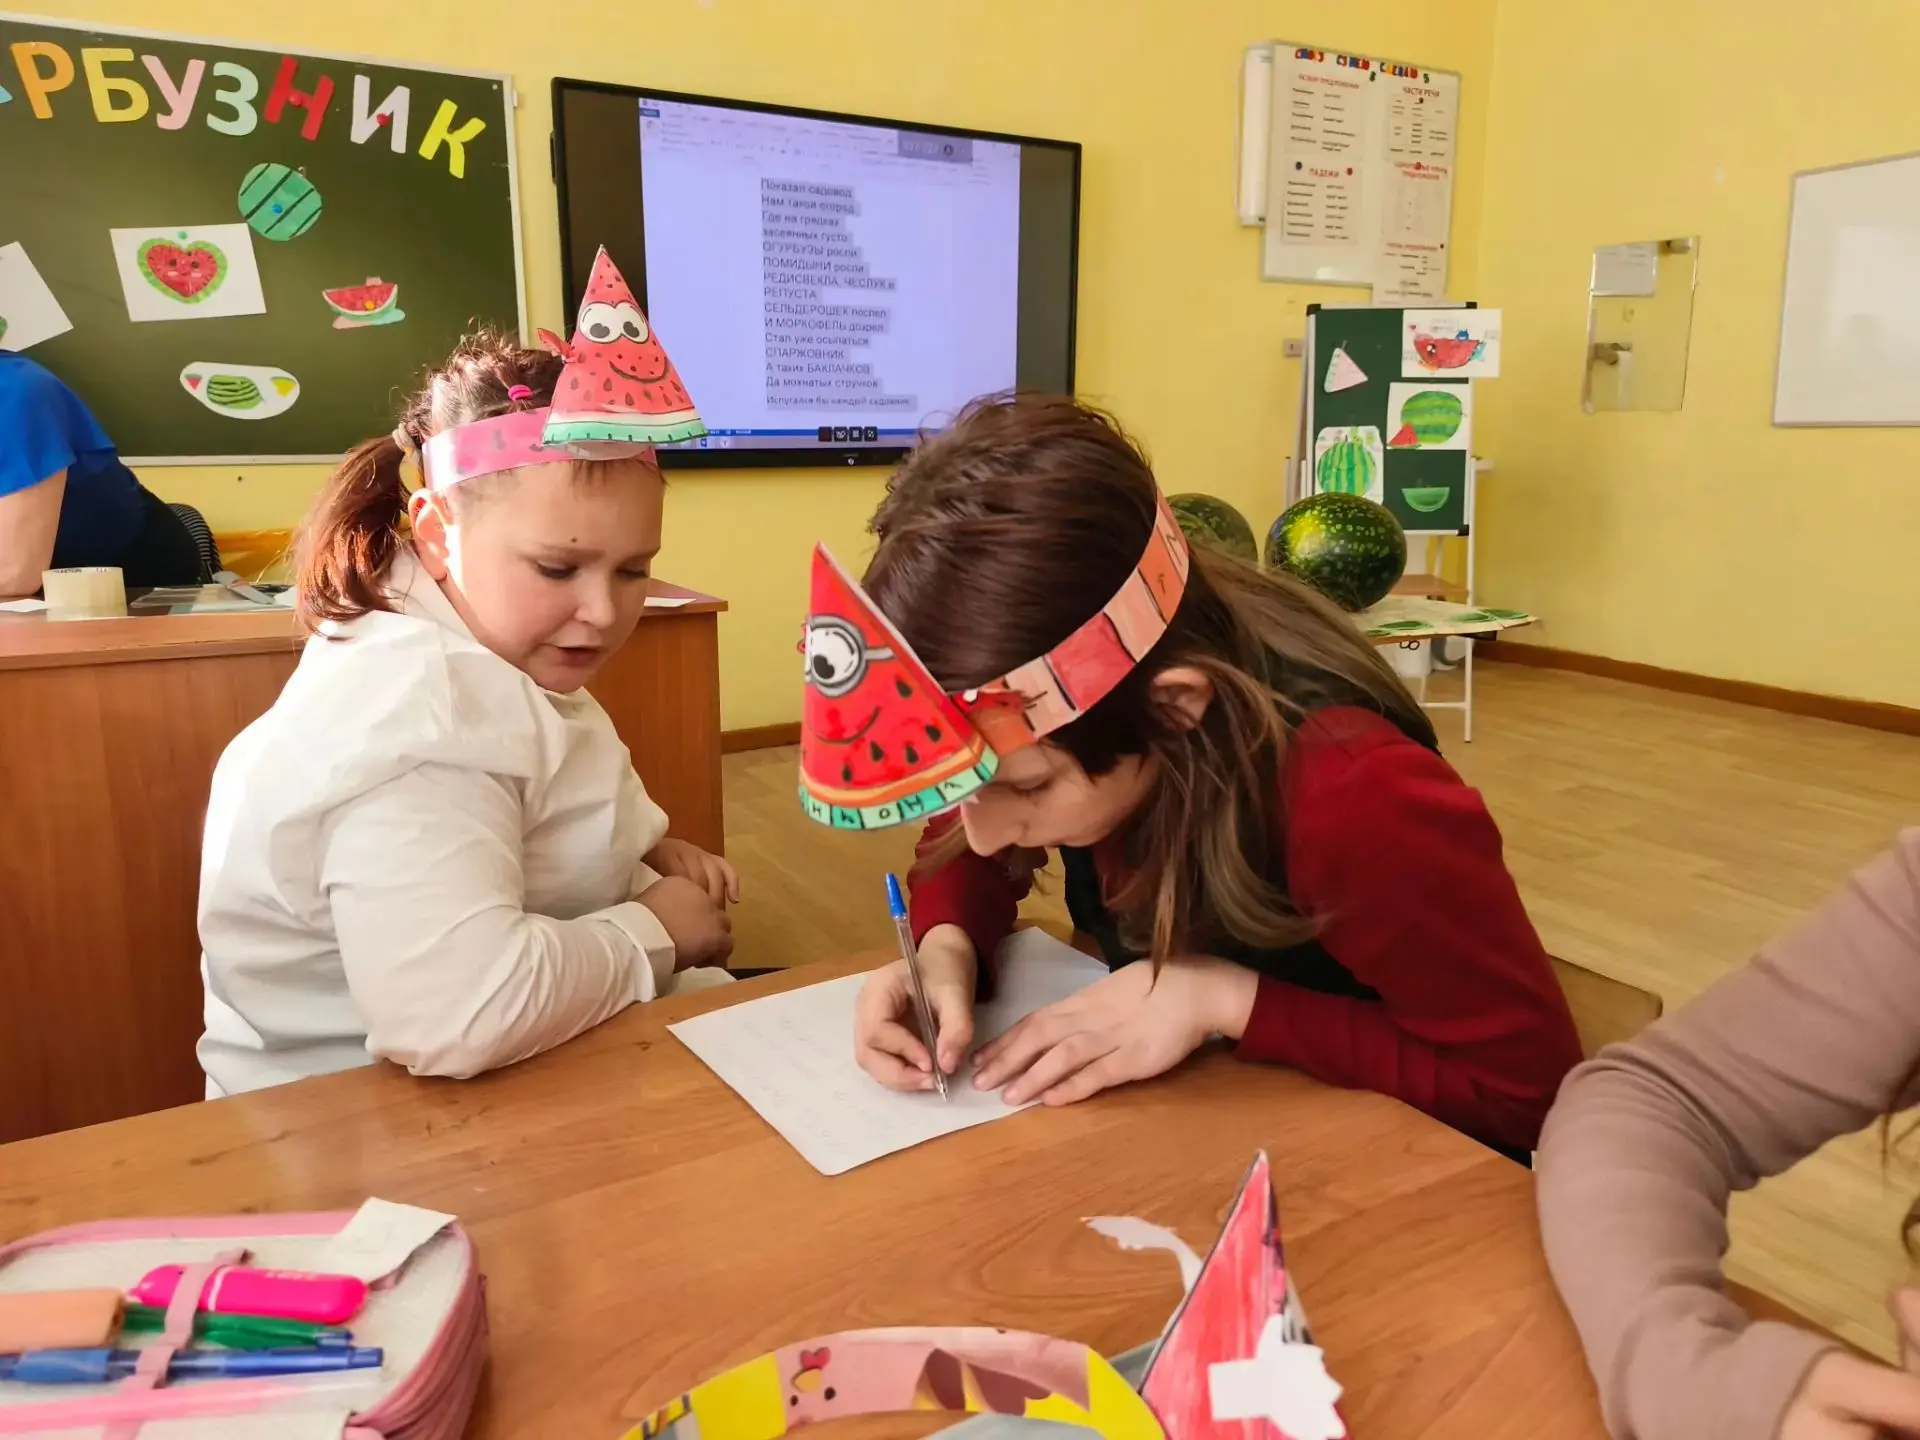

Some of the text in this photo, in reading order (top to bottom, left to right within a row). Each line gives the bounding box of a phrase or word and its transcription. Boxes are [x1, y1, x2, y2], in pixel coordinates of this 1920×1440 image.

[0, 41, 486, 179] РБУЗНИК
[761, 194, 784, 205] Нам
[762, 211, 781, 223] Где
[784, 215, 797, 223] на
[763, 241, 824, 255] ОГУРБУЗЫ
[763, 256, 832, 270] ПОМИДЫНИ
[764, 302, 849, 316] СЕЛЬДЕРОШЕК
[765, 318, 773, 327] И
[776, 318, 847, 331] МОРКОФЕЛЬ
[765, 332, 791, 343] Стал
[794, 335, 814, 345] уже
[766, 362, 870, 374] А таких БАКЛАЧКОВ
[766, 376, 780, 388] Да
